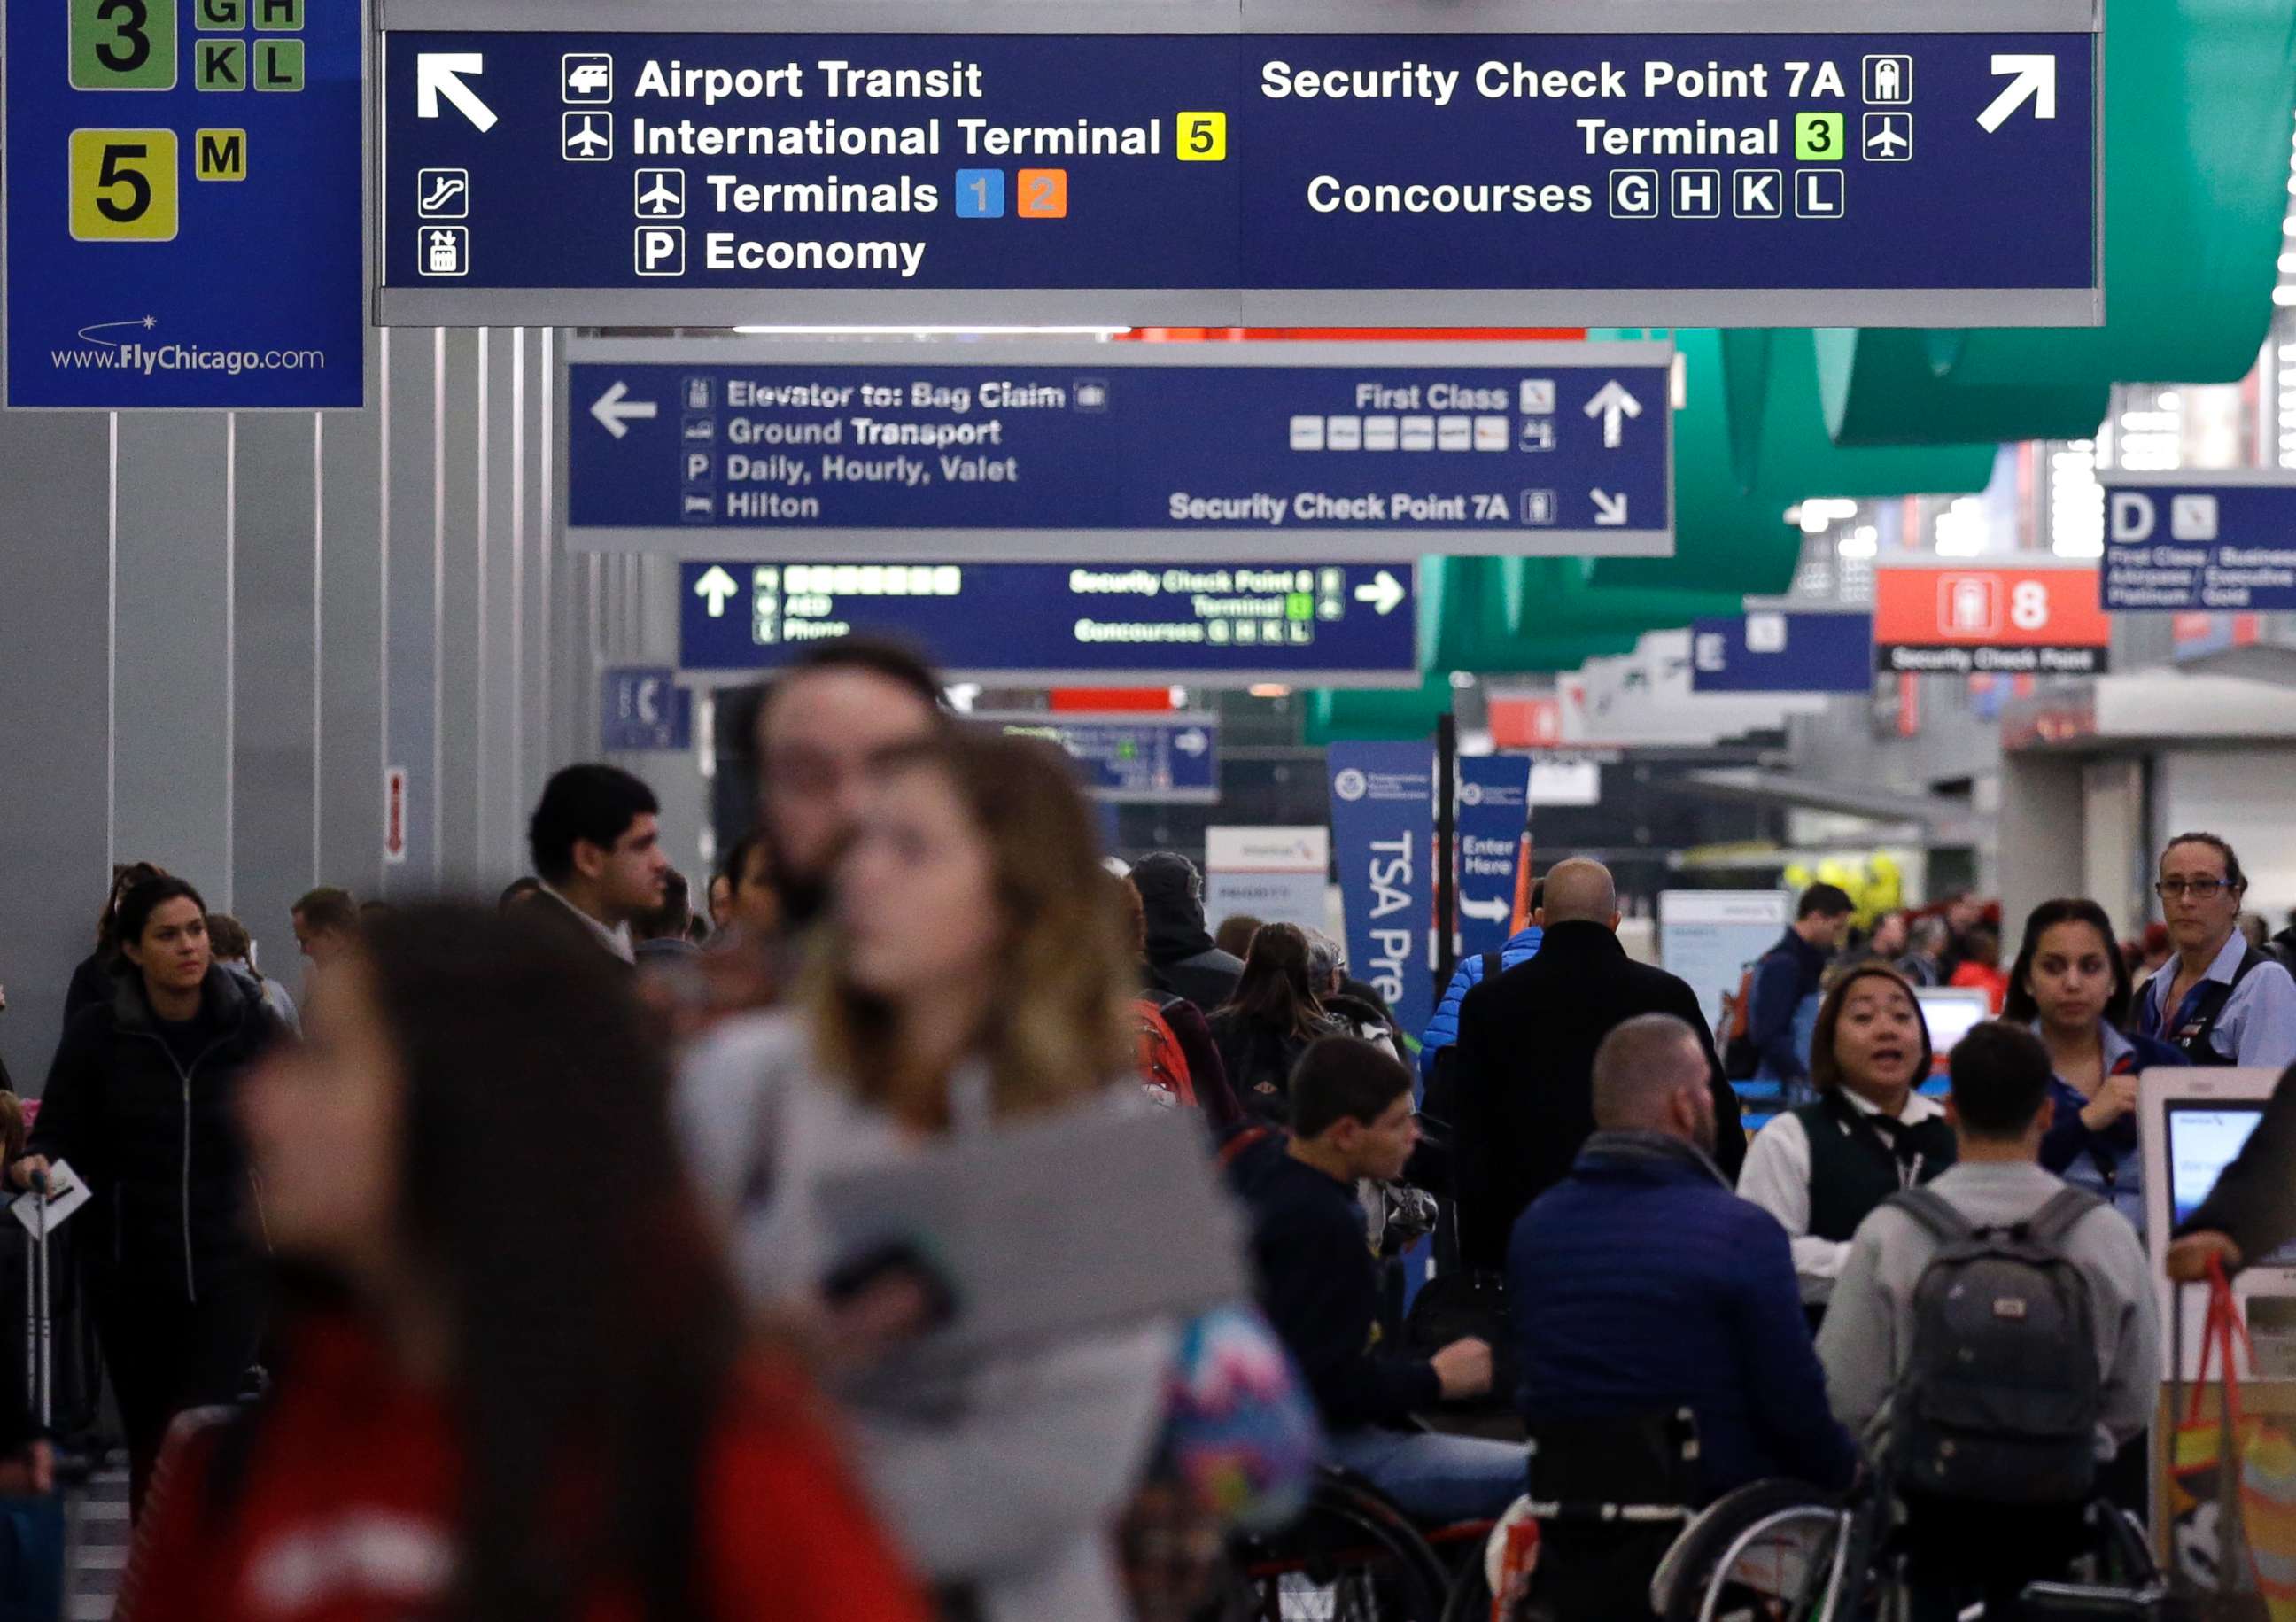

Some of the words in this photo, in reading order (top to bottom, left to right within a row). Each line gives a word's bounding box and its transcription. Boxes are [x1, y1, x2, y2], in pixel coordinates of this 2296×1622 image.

[96, 0, 151, 72] 3
[204, 0, 236, 22] G
[264, 0, 293, 22] H
[206, 46, 237, 83] K
[267, 47, 292, 83] L
[634, 60, 803, 105] Airport
[818, 61, 982, 97] Transit
[1260, 61, 1459, 105] Security
[1475, 61, 1627, 97] Check
[1644, 61, 1768, 97] Point
[1785, 62, 1845, 97] 7A
[633, 119, 939, 154] International
[958, 119, 1160, 154] Terminal
[1190, 120, 1214, 153] 5
[1577, 119, 1778, 154] Terminal
[1807, 119, 1831, 153] 3
[96, 144, 151, 222] 5
[202, 136, 240, 173] M
[707, 176, 938, 212] Terminals
[970, 177, 986, 212] 1
[1030, 176, 1055, 210] 2
[1307, 175, 1591, 212] Concourses
[1617, 175, 1649, 212] G
[1680, 175, 1710, 211] H
[1742, 175, 1775, 211] K
[1808, 175, 1834, 211] L
[646, 232, 675, 269] P
[706, 233, 926, 276] Economy
[51, 342, 324, 375] www.FlyChicago.com
[726, 381, 854, 409] Elevator
[860, 382, 903, 408] to:
[911, 381, 972, 414] Bag
[978, 381, 1066, 409] Claim
[1356, 383, 1420, 410] First
[1427, 383, 1509, 411] Class
[728, 417, 842, 445] Ground
[850, 417, 1002, 449] Transport
[727, 454, 811, 485] Daily,
[822, 454, 931, 485] Hourly,
[940, 454, 1018, 483] Valet
[727, 492, 819, 518] Hilton
[1168, 493, 1287, 525] Security
[1293, 493, 1385, 520] Check
[1391, 493, 1466, 521] Point
[1471, 493, 1510, 521] 7A
[2111, 492, 2155, 543] D
[2012, 580, 2048, 630] 8
[1462, 834, 1514, 858] Enter
[1369, 830, 1413, 919] TSA
[1464, 858, 1512, 877] Here
[1369, 927, 1412, 1004] Pre
